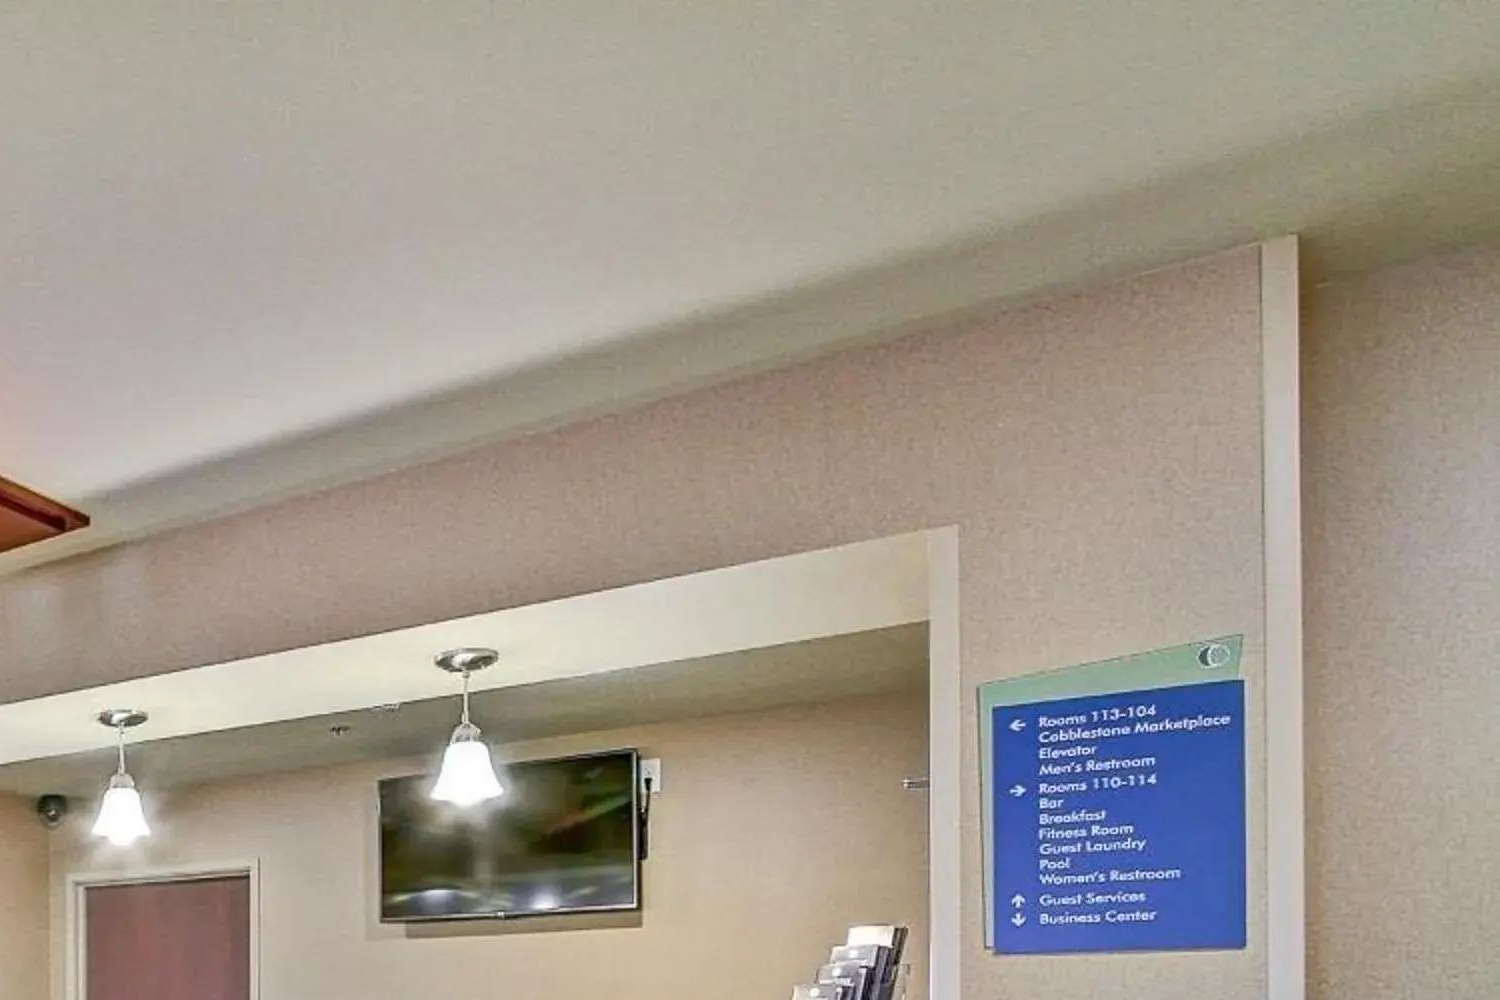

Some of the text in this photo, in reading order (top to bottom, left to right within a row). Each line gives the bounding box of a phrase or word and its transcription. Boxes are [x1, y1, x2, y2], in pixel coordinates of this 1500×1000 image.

[1038, 714, 1087, 728] Rooms
[1038, 715, 1231, 743] Cobblestone Marketplace
[1038, 744, 1097, 759] Elevator
[1039, 756, 1156, 776] Men's Restroom
[1038, 774, 1157, 795] Rooms 110-114
[1038, 798, 1064, 809] Bar
[1038, 809, 1107, 825] Breakfast
[1038, 824, 1134, 840] Fitness Room
[1039, 837, 1147, 855] Guest Laundry
[1038, 857, 1071, 870] Pool
[1039, 868, 1181, 885] Women's Restroom
[1039, 890, 1147, 906] Guest Services
[1039, 909, 1157, 925] Business Center
